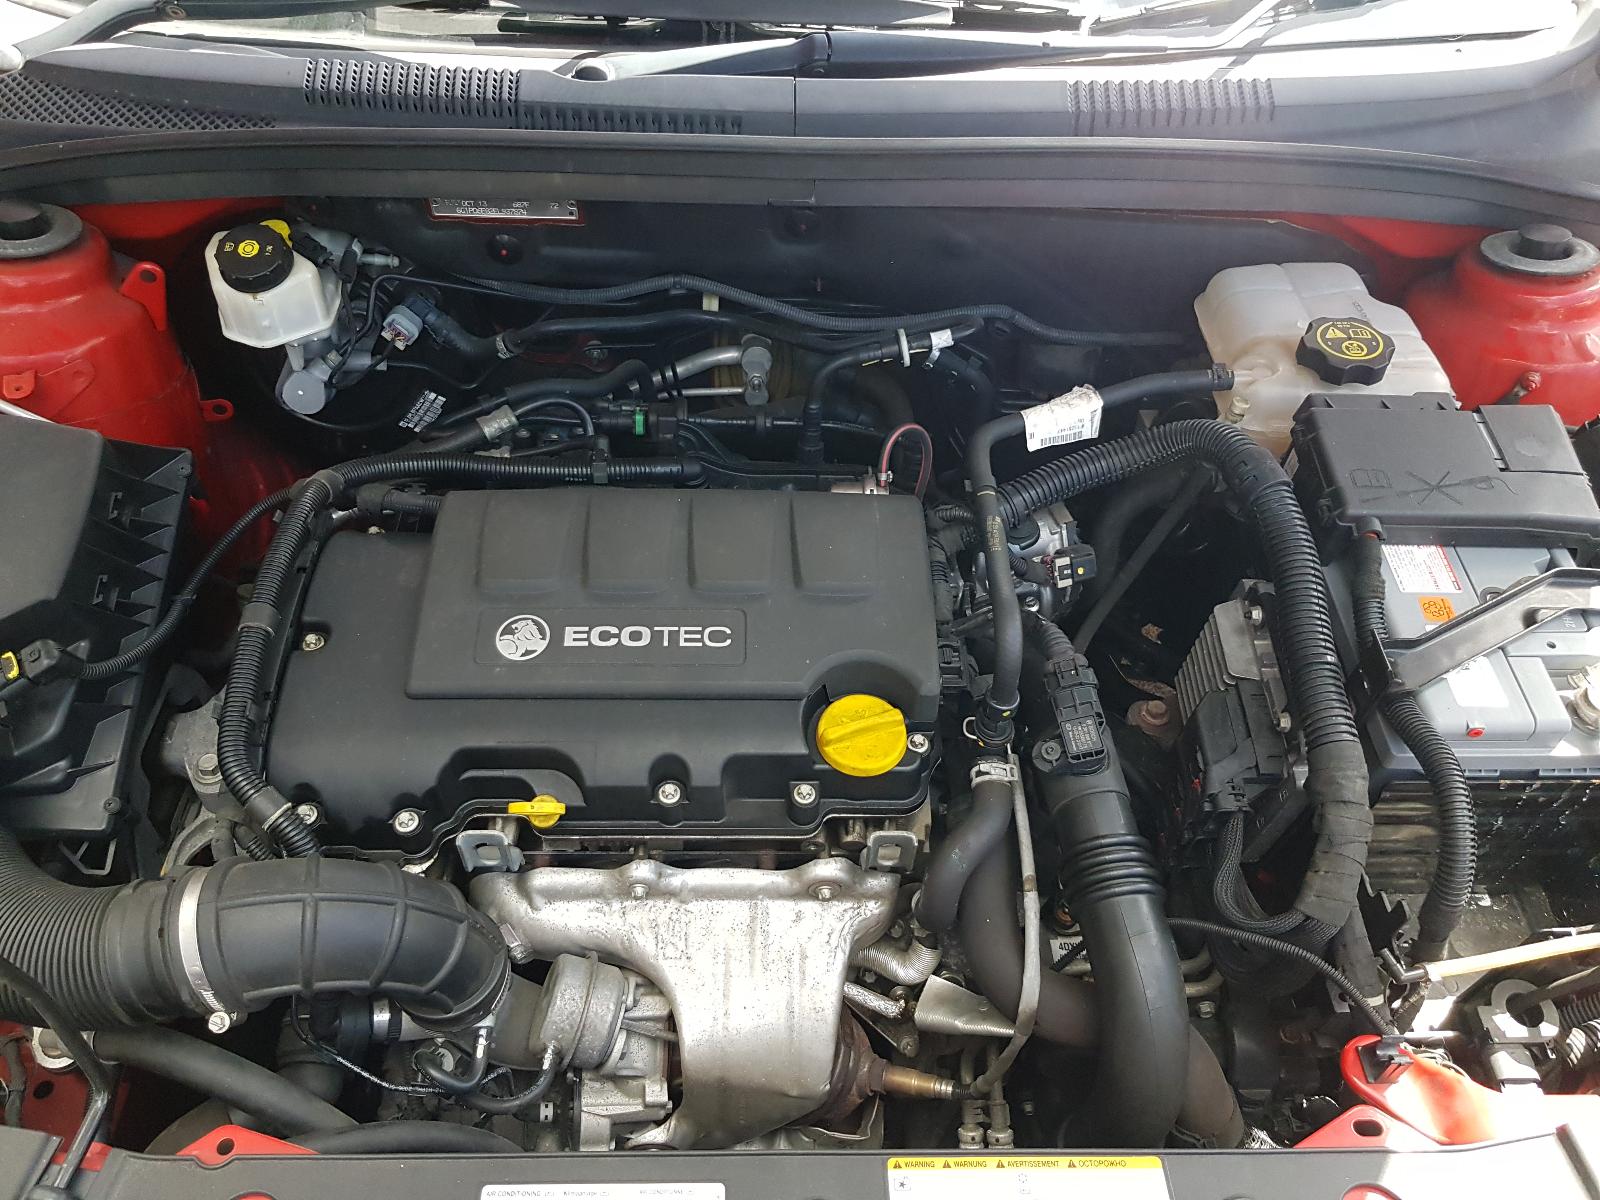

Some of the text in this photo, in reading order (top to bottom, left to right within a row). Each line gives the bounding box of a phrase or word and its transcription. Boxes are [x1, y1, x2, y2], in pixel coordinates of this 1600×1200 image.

[563, 625, 732, 648] ECOTEC
[904, 1160, 936, 1168] WARNING
[953, 1160, 987, 1168] WARNUNG
[1007, 1160, 1059, 1168] AVERTISSEMENT
